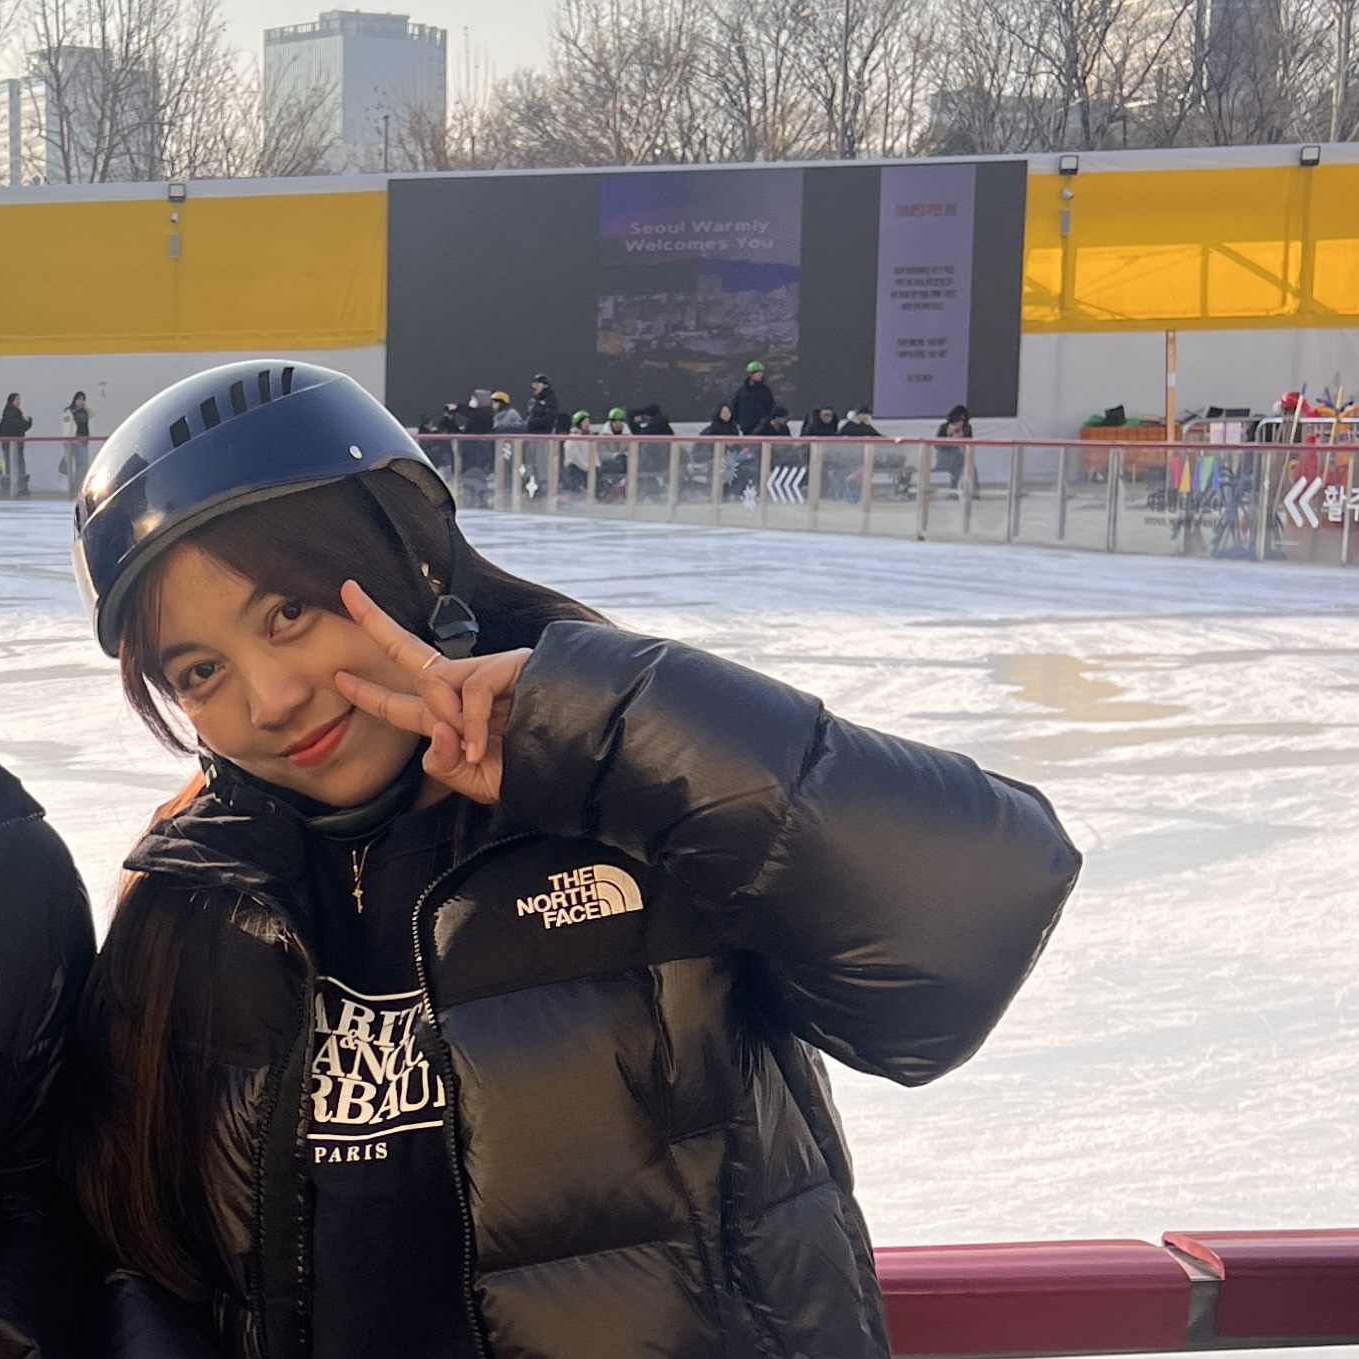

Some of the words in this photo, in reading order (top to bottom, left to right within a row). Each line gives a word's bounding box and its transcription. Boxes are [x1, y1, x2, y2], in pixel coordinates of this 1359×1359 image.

[629, 220, 686, 235] Seoul
[692, 219, 770, 234] Warmly
[625, 238, 729, 252] Welcomes
[736, 236, 774, 250] You
[547, 865, 595, 891] THE
[516, 883, 598, 917] NORTH
[543, 902, 602, 930] FACE
[313, 1141, 389, 1164] PARIS
